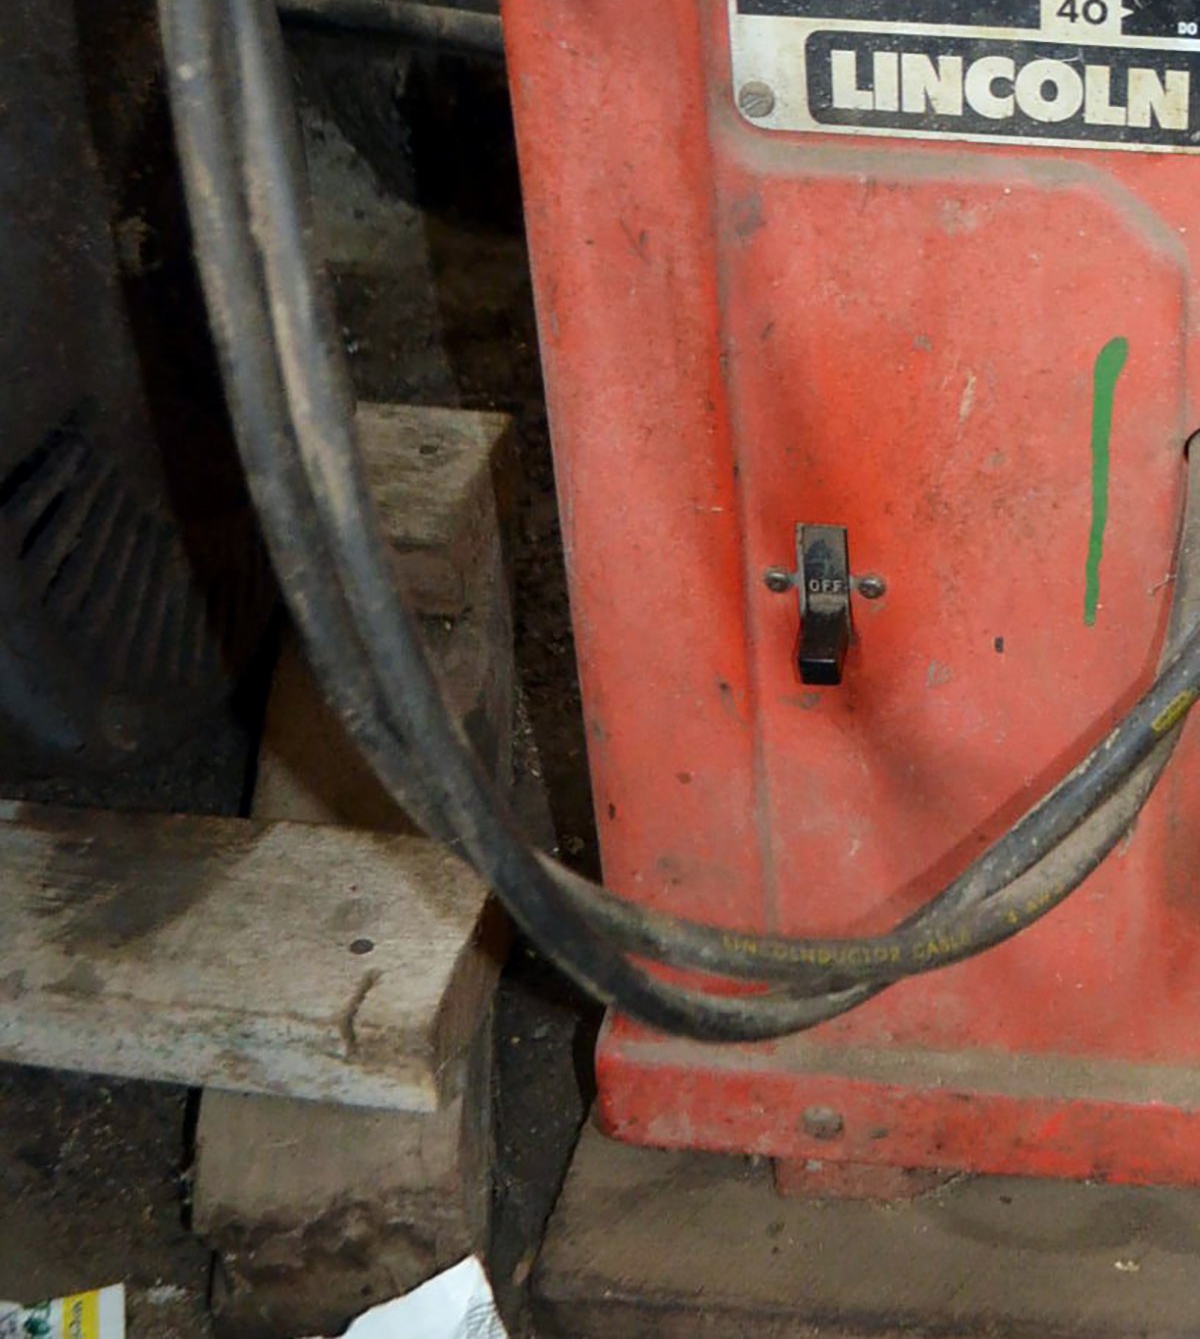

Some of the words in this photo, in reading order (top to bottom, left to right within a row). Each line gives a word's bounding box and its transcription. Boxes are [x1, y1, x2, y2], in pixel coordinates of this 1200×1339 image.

[1177, 22, 1198, 35] DO
[830, 49, 1189, 130] LINCOLN
[808, 579, 843, 592] OFF
